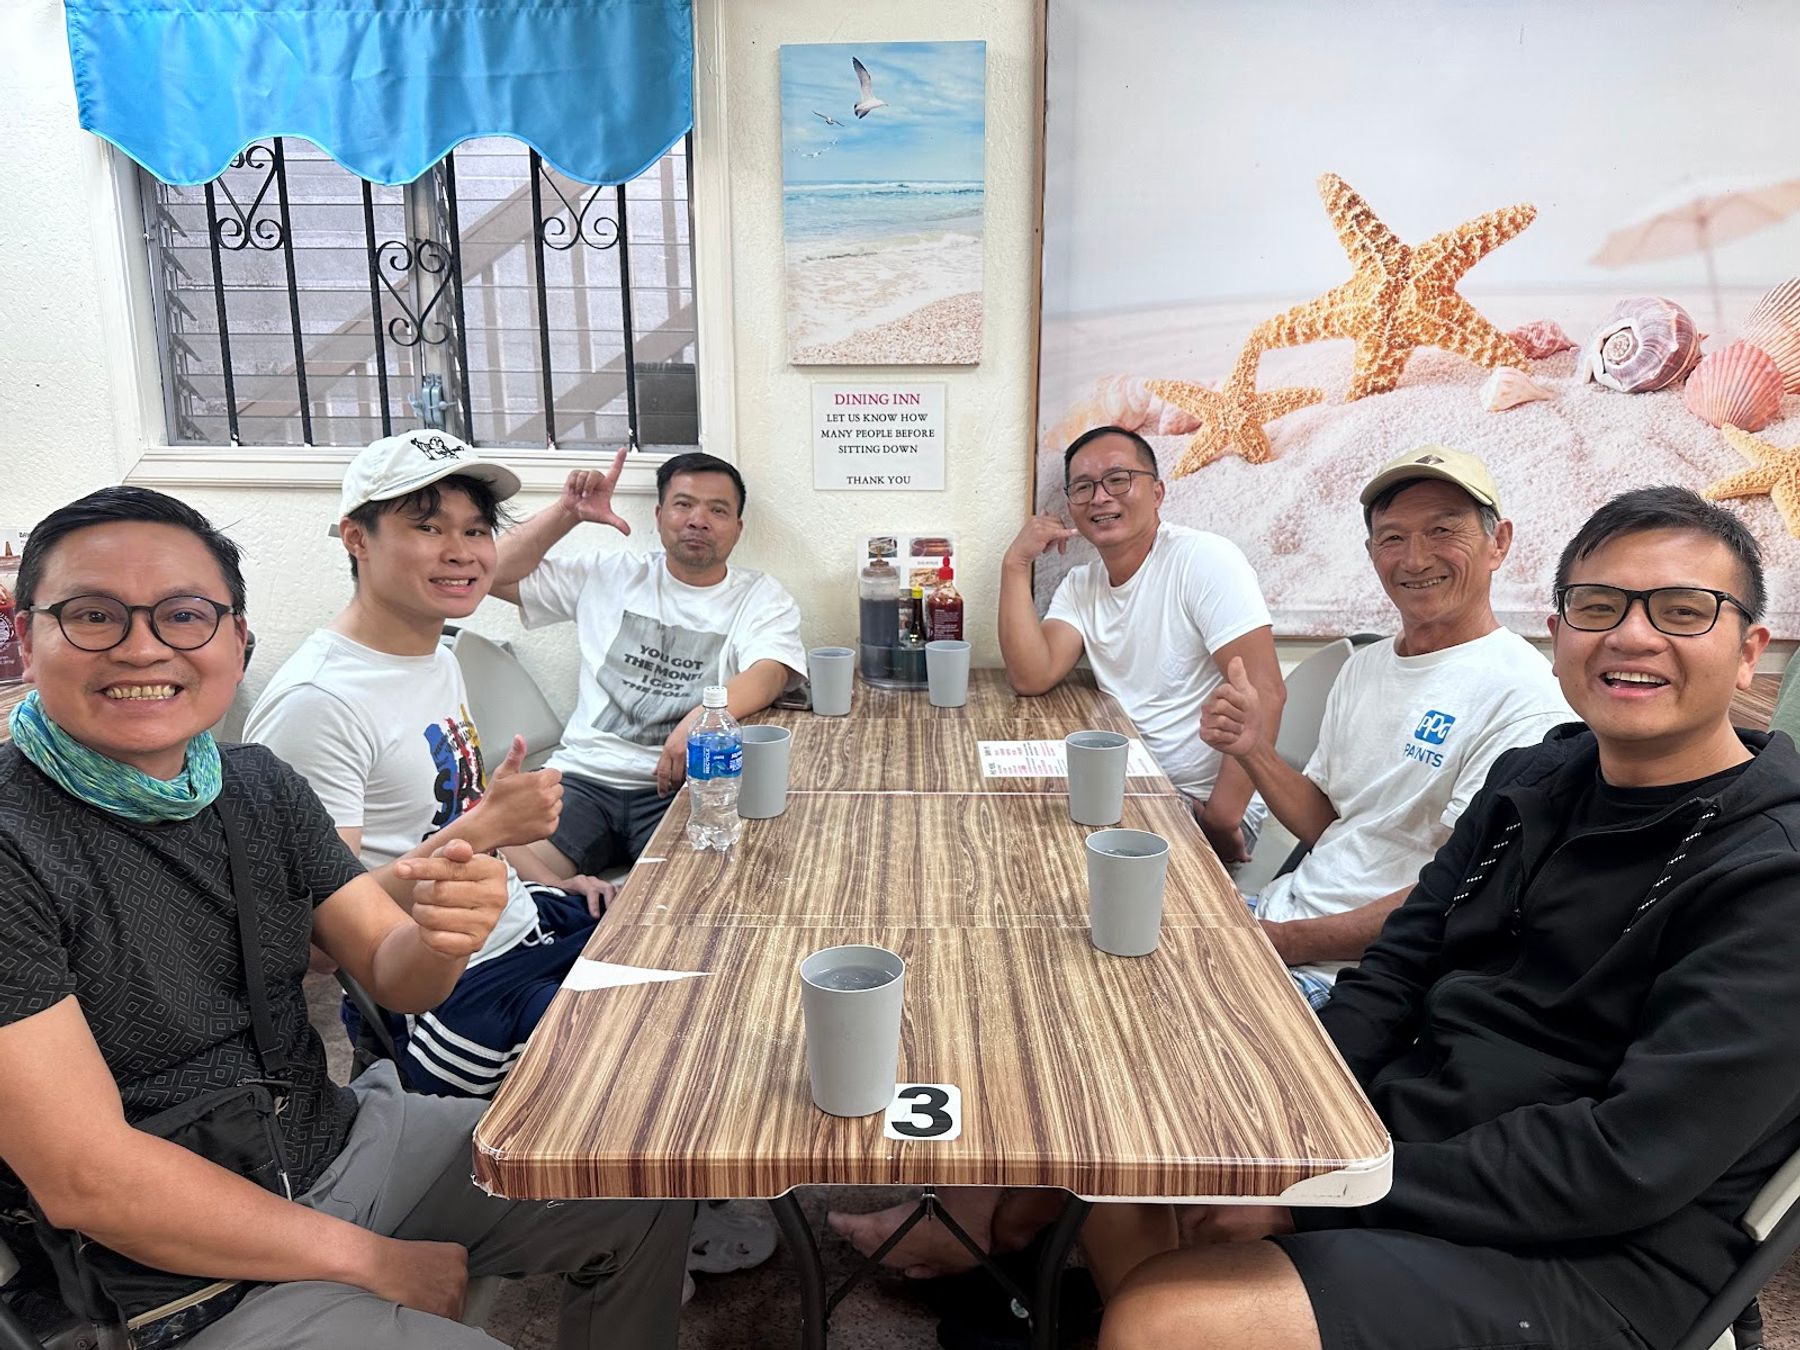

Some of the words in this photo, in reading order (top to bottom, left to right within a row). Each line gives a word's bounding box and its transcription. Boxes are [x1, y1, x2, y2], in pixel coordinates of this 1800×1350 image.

[834, 393, 889, 405] DINING
[893, 393, 921, 405] INN
[826, 413, 845, 422] LET
[848, 413, 861, 422] US
[863, 413, 897, 422] KNOW
[900, 413, 929, 422] HOW
[820, 429, 853, 438] MANY
[855, 429, 893, 438] PEOPLE
[895, 429, 935, 438] BEFORE
[838, 445, 880, 454] SITTING
[882, 445, 919, 454] DOWN
[846, 476, 885, 485] THANK
[887, 475, 911, 485] YOU
[624, 653, 655, 671] THE
[640, 644, 669, 663] YOU
[670, 658, 704, 671] GOT
[642, 674, 649, 683] I
[650, 678, 685, 691] GOT
[1417, 713, 1453, 739] PPG
[891, 1086, 953, 1138] 3
